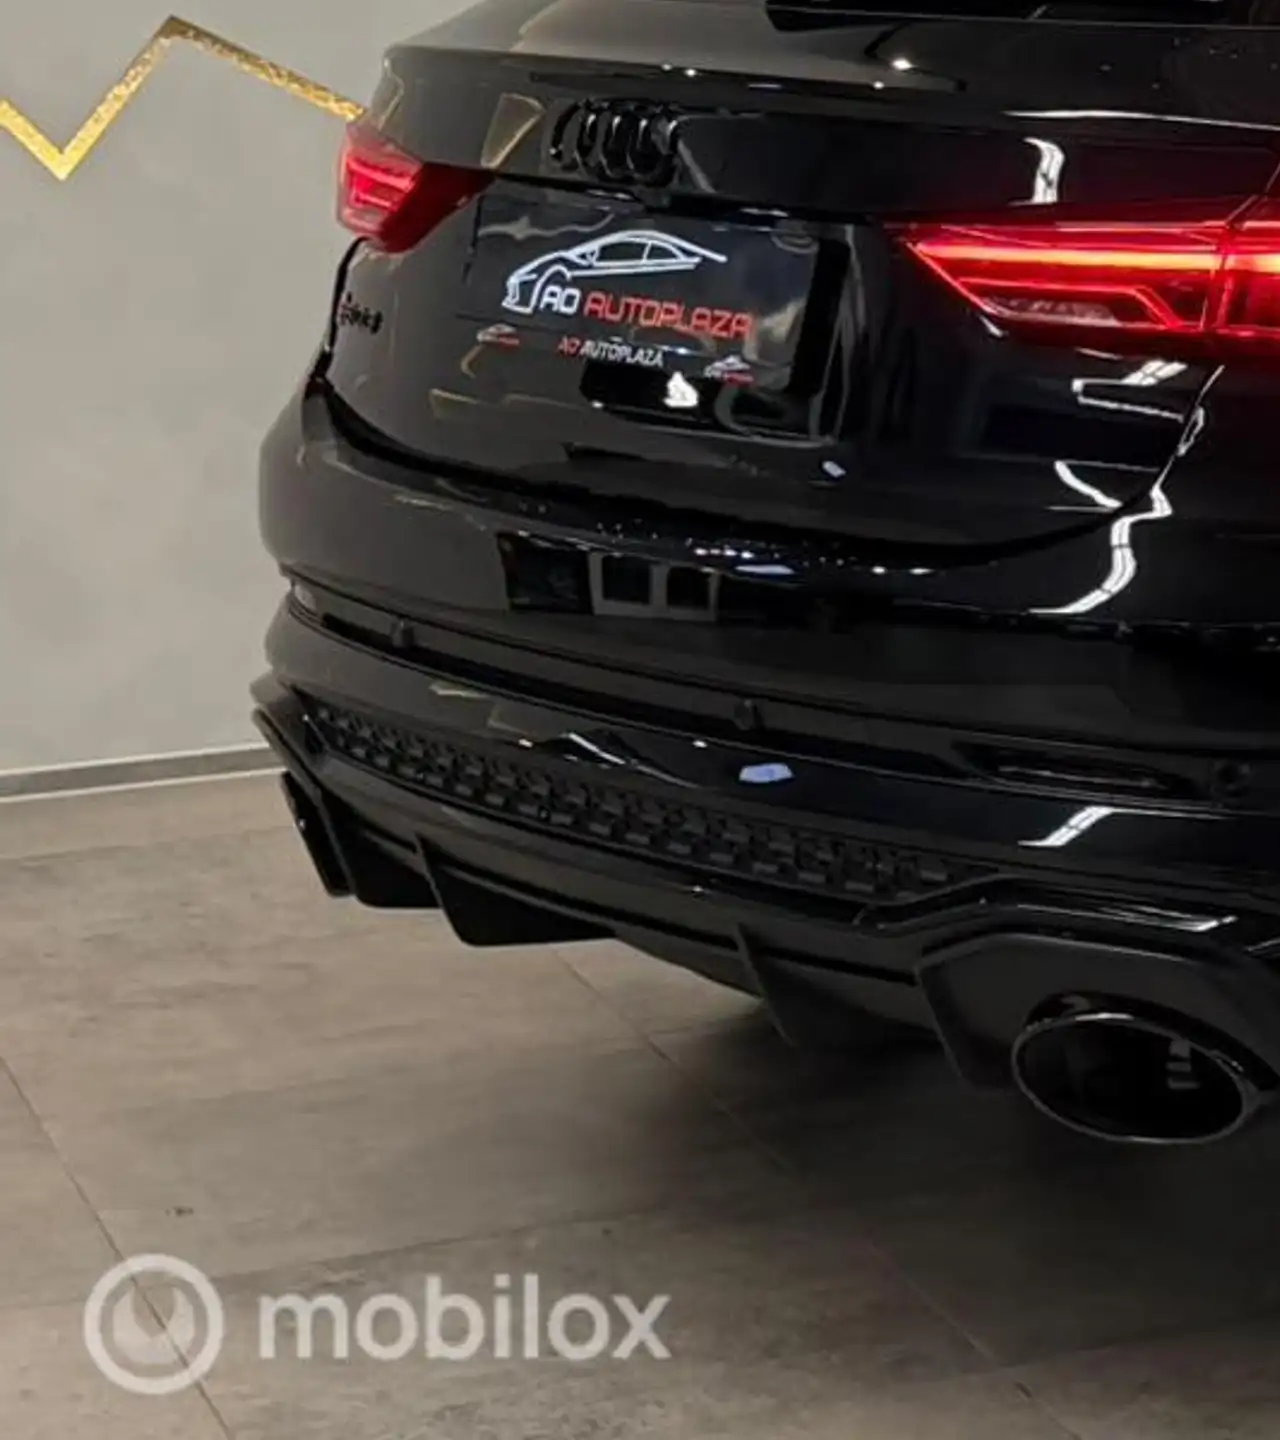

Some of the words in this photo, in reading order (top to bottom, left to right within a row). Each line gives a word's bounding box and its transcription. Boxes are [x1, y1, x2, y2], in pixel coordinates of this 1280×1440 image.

[540, 285, 581, 314] AO
[584, 291, 754, 337] AUTOPLAZA
[579, 339, 663, 368] AUTOPLAZA
